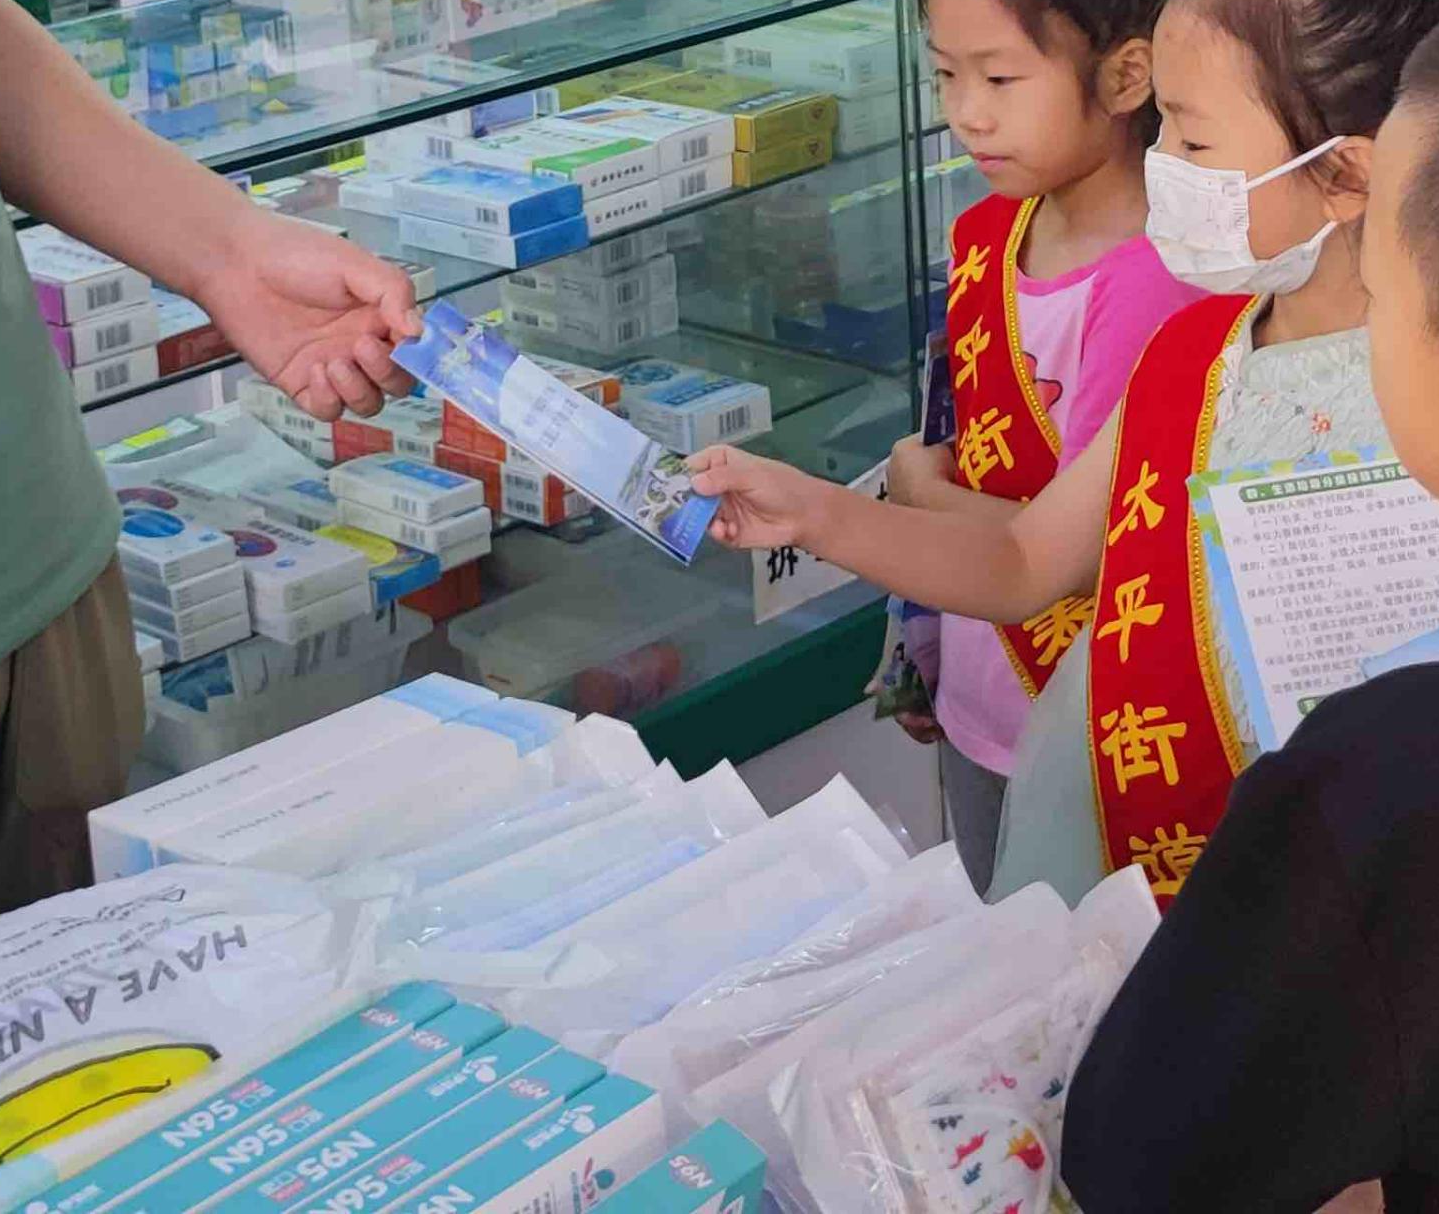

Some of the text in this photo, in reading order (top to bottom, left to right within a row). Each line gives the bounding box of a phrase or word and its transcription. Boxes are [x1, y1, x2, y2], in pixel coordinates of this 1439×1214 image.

[946, 241, 1015, 493] 太平街
[1096, 460, 1211, 888] 太平街道
[118, 923, 249, 1005] HAVE
[64, 990, 91, 1027] A
[161, 1098, 240, 1150] N95
[209, 1122, 289, 1176] N95
[296, 1130, 378, 1183] N95
[669, 1153, 713, 1189] N95
